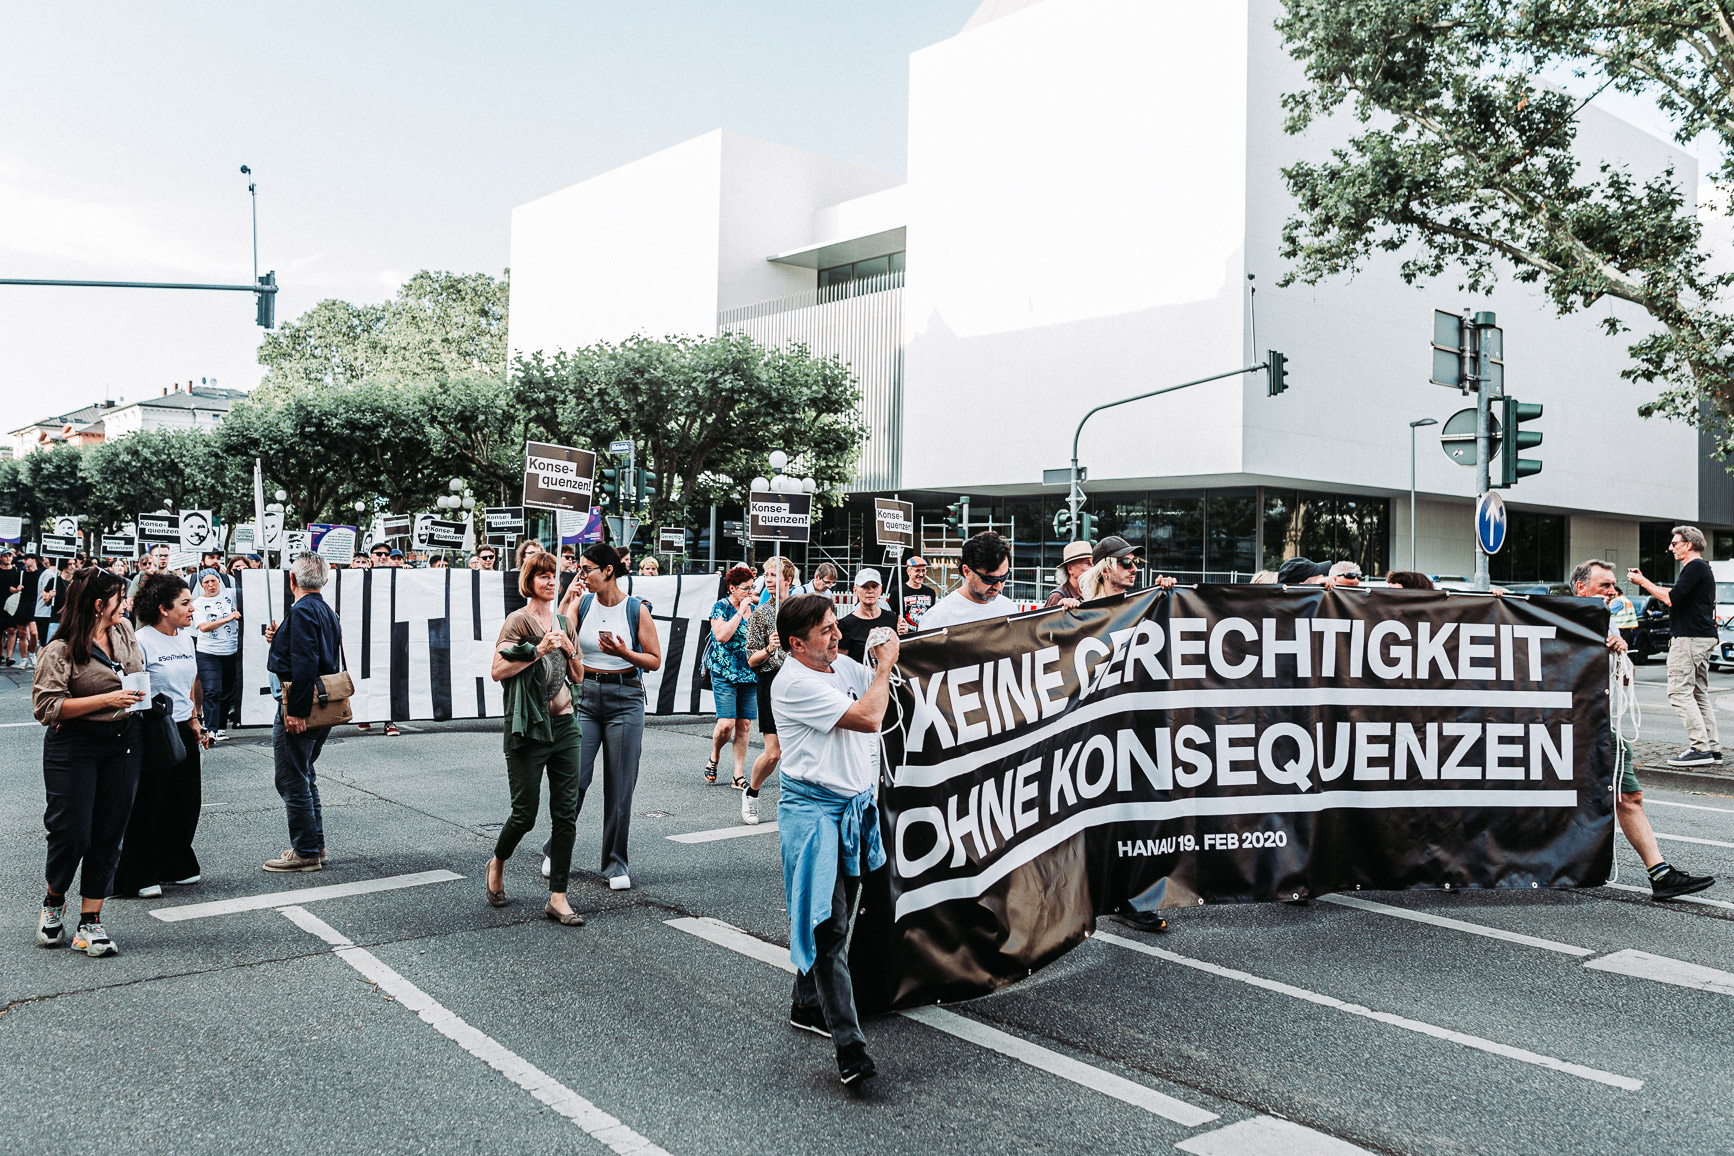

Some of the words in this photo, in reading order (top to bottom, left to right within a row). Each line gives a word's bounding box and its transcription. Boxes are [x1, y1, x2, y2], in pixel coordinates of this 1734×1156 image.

[528, 457, 574, 474] Konse-
[542, 475, 592, 492] quenzen!
[751, 502, 787, 513] Konse-
[760, 515, 808, 525] quenzen!
[877, 509, 902, 520] Konse-
[139, 520, 167, 528] Konse-
[430, 526, 453, 534] Konse-
[435, 533, 464, 541] quenzen!
[906, 645, 1069, 752] KEINE
[1073, 617, 1557, 700] GERECHTIGKEIT
[895, 757, 1043, 879] OHNE
[1049, 722, 1574, 815] KONSEQUENZEN
[1117, 836, 1176, 857] HANAU
[1177, 835, 1199, 851] 19.
[1203, 833, 1239, 850] FEB
[1241, 831, 1288, 848] 2020
